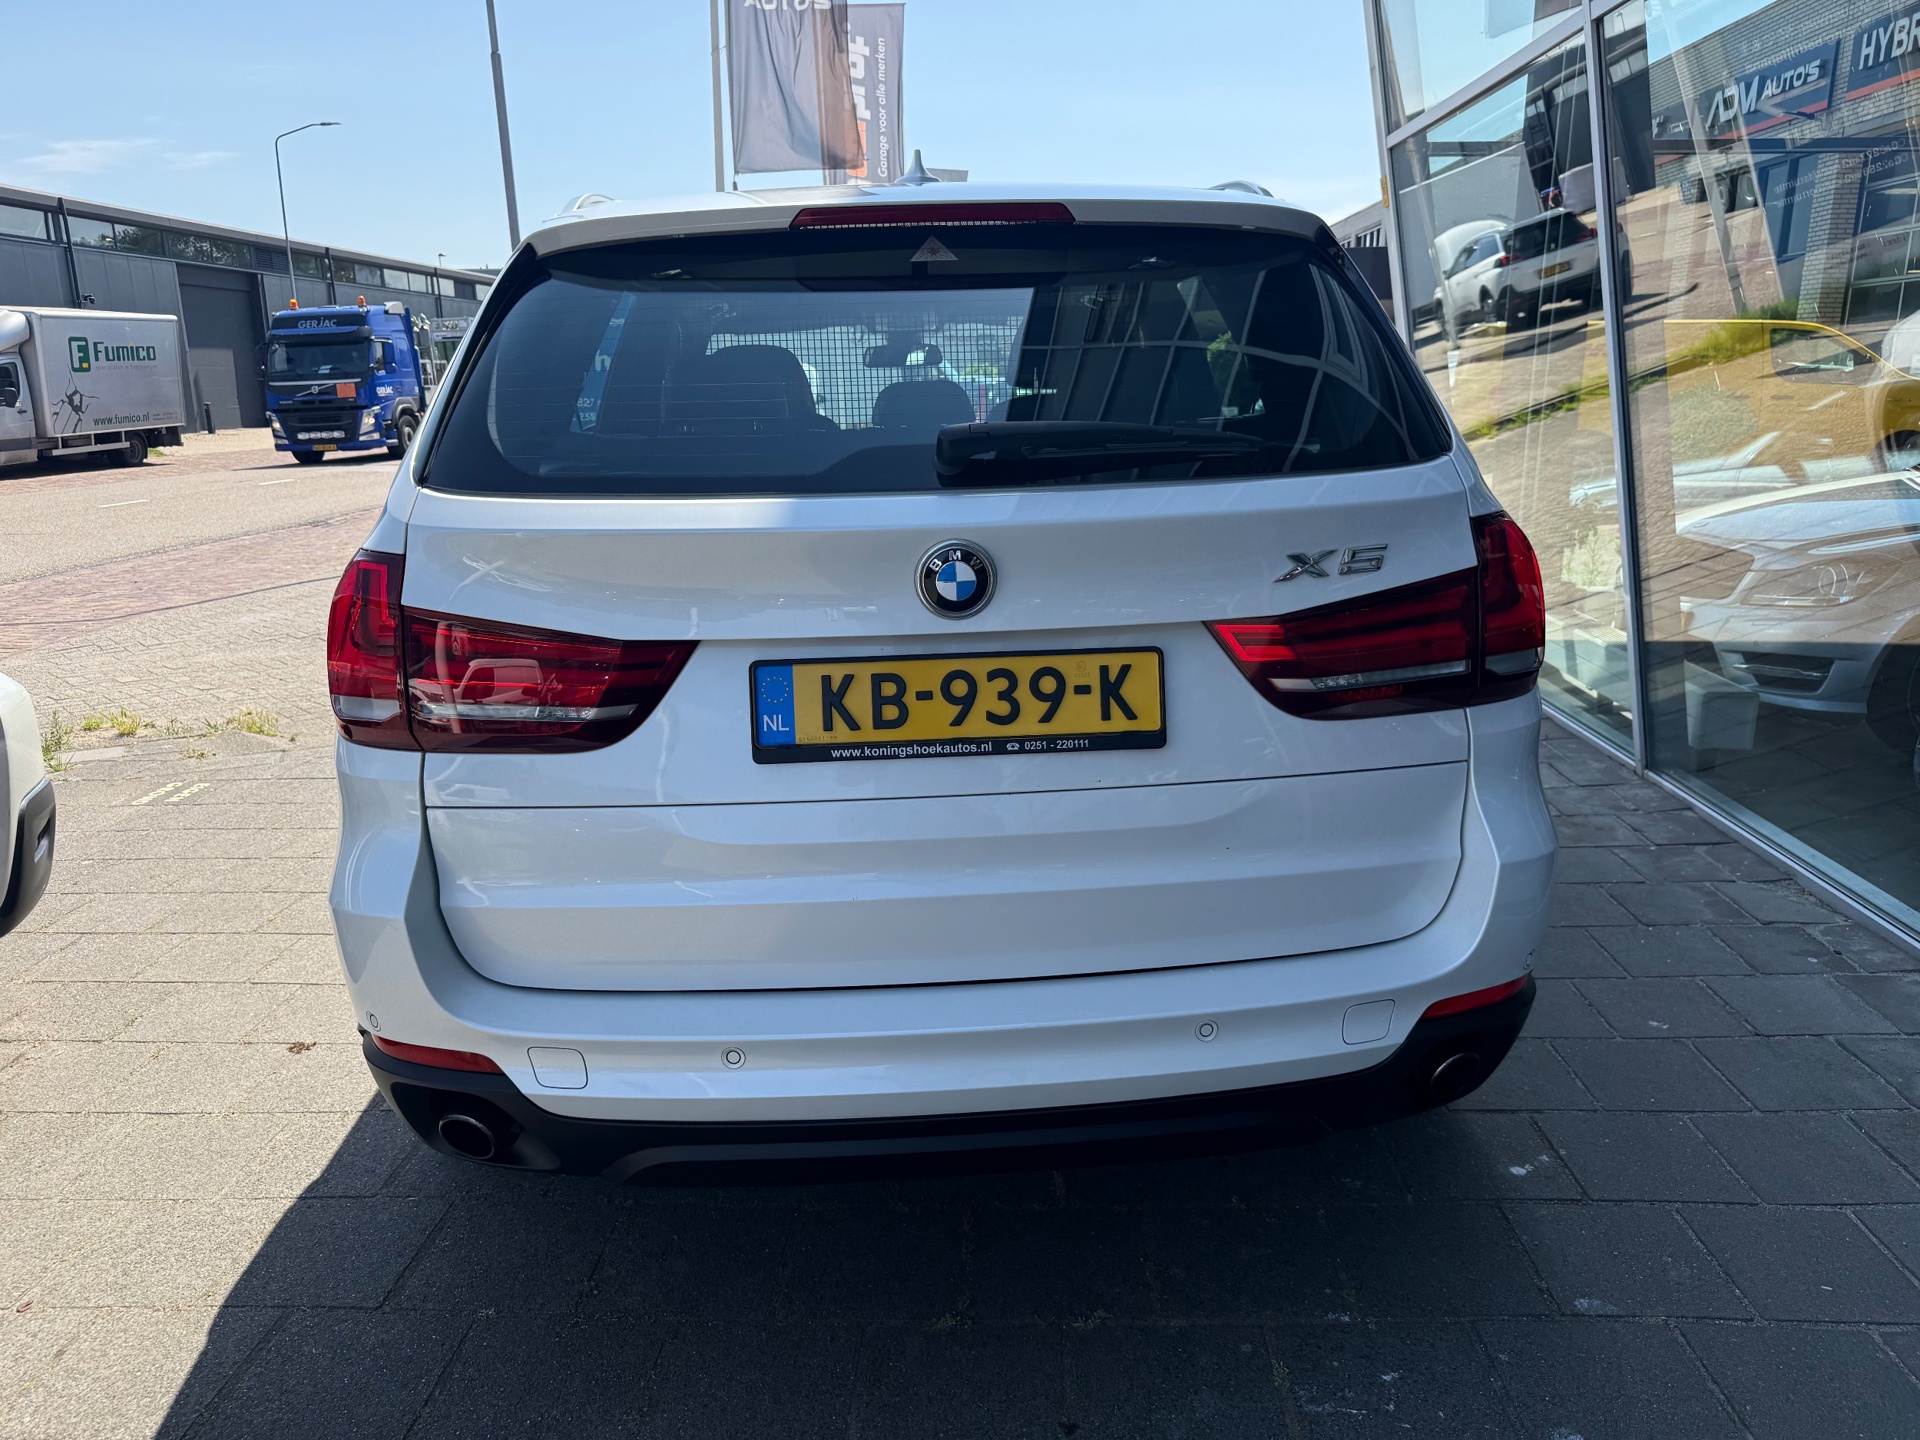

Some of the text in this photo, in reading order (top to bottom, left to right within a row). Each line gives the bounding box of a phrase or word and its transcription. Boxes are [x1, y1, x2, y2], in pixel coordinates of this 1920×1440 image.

[1760, 59, 1821, 100] AUTO'S
[875, 37, 889, 178] Garage voor alle merken
[93, 341, 157, 362] Fumico
[92, 412, 150, 426] www.fumico.nl
[929, 550, 983, 573] BMW
[1272, 543, 1389, 583] X5
[821, 664, 1138, 731] KB-939-K
[763, 713, 790, 732] NL
[831, 741, 993, 758] www.koningshoekautos.nl
[1024, 740, 1047, 751] 0251
[1056, 739, 1089, 749] 220111
